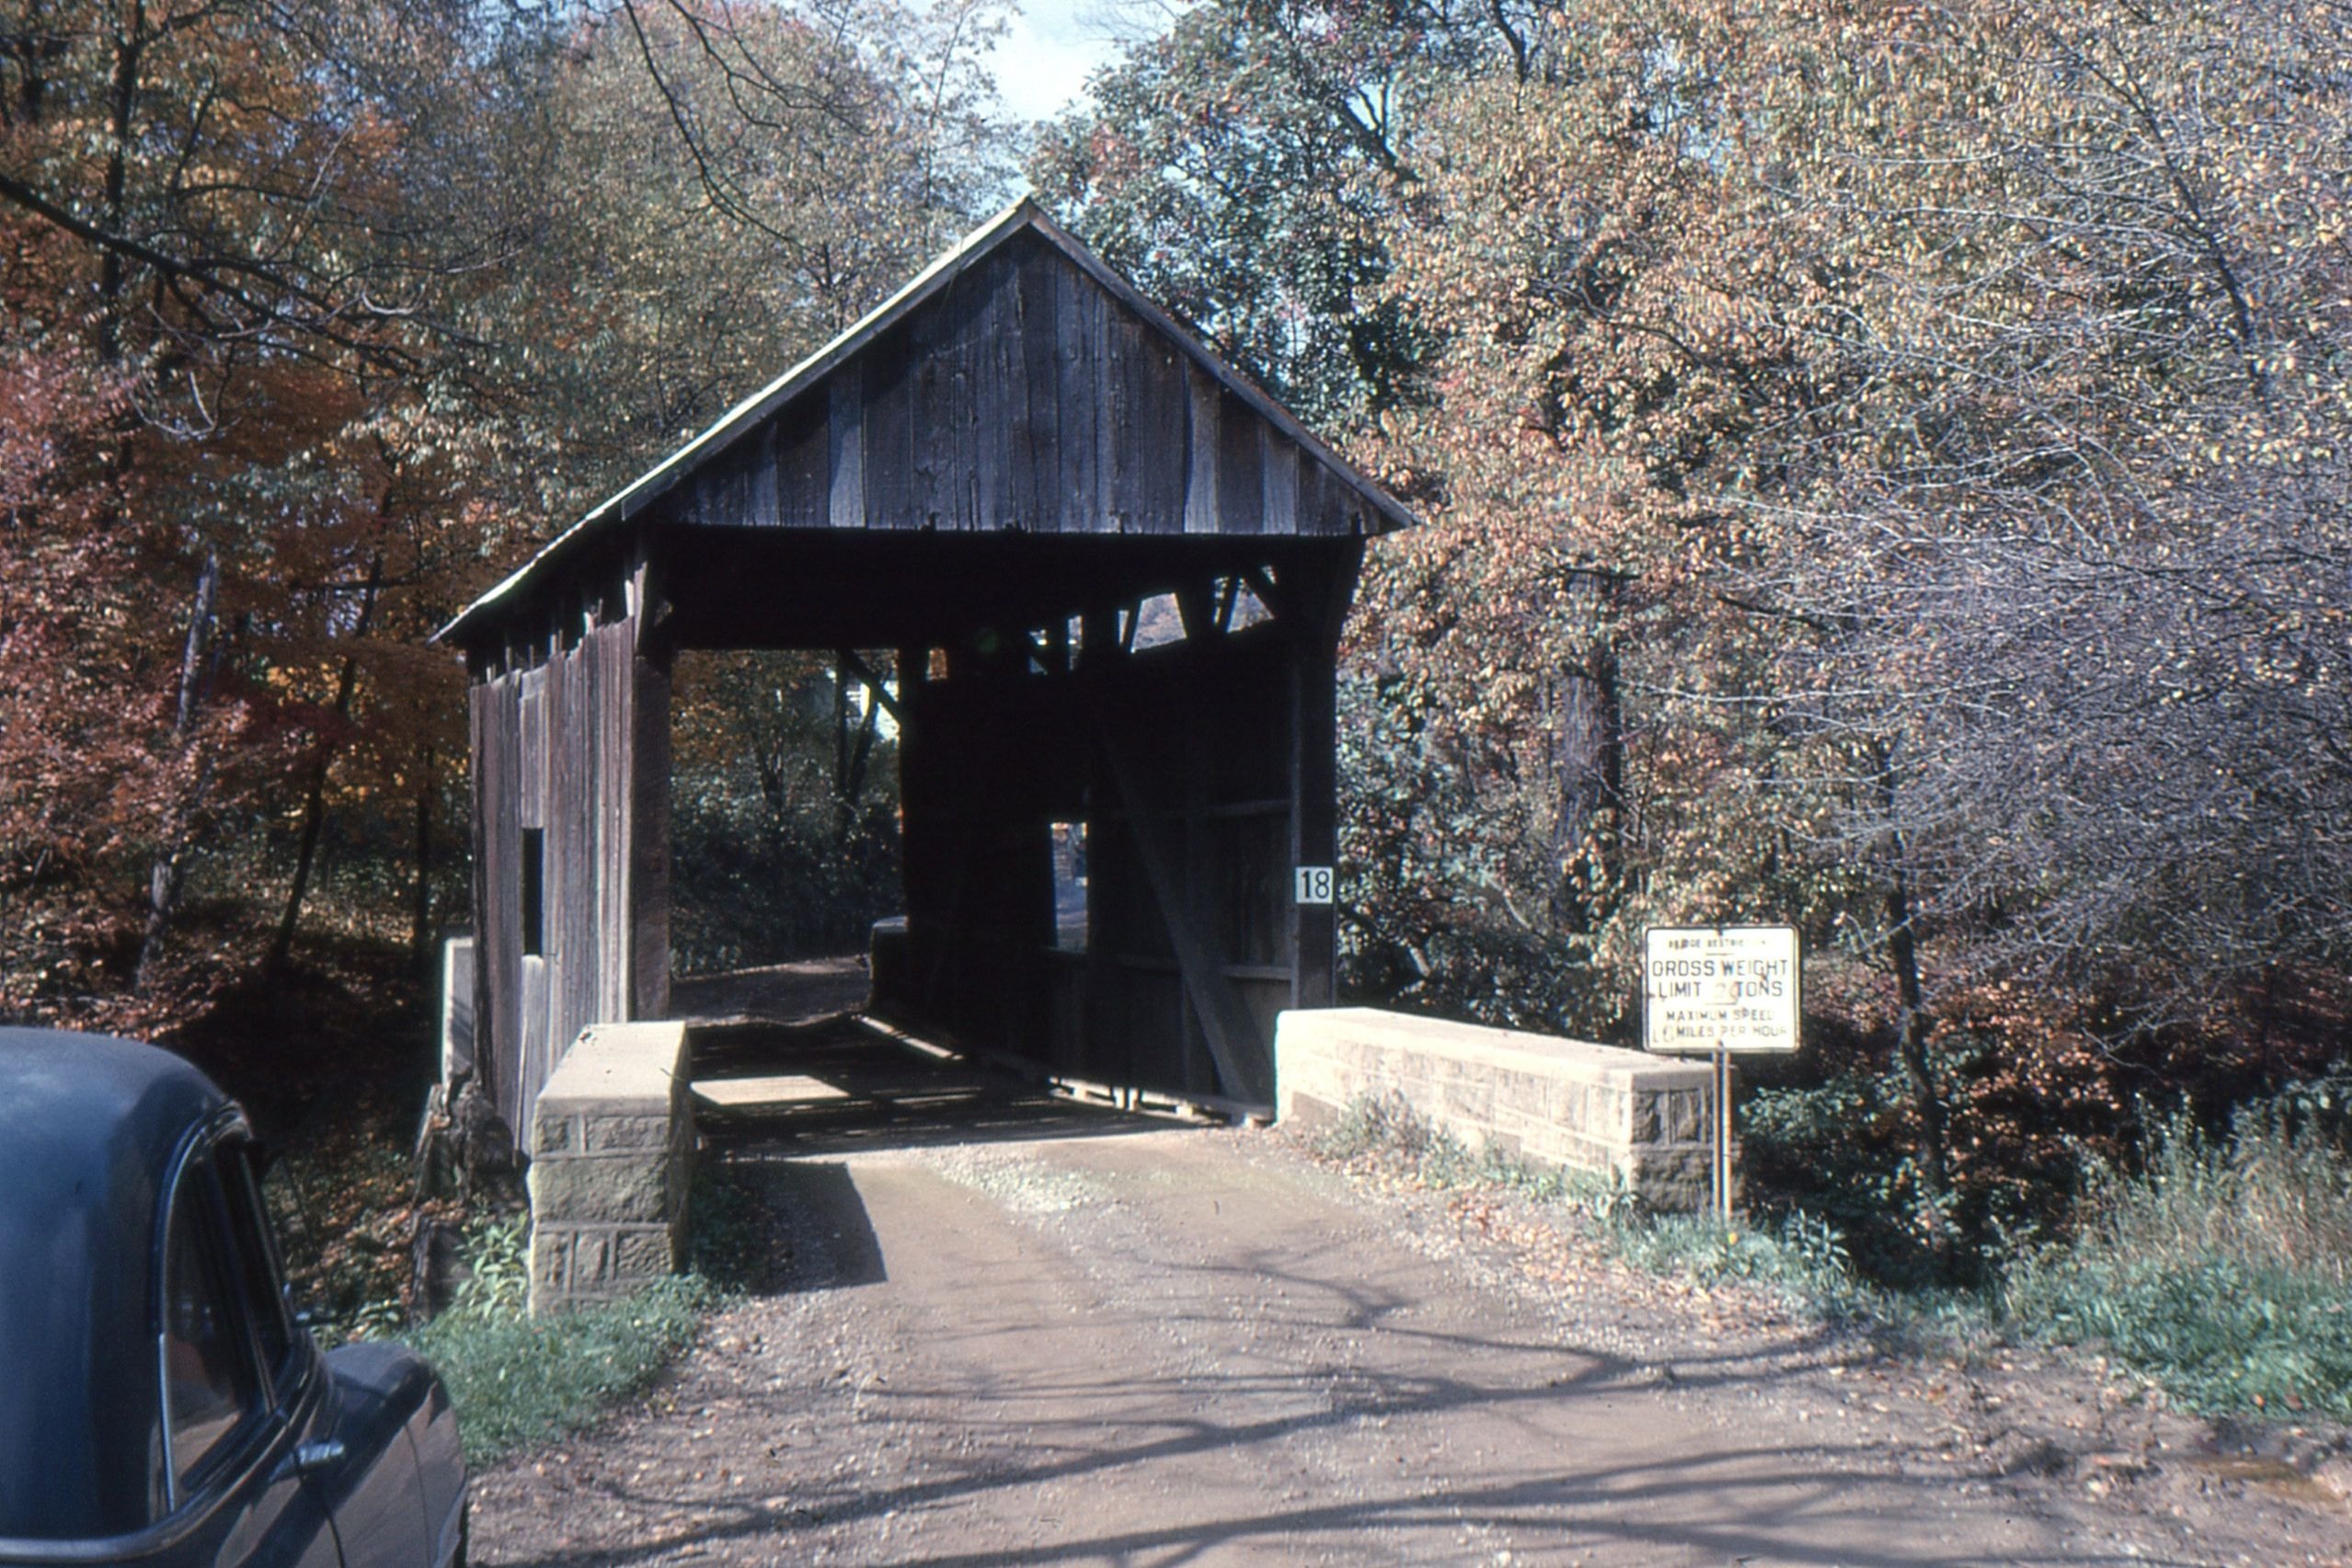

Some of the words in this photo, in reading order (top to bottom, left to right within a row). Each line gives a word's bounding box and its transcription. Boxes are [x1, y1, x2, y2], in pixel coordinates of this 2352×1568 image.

[1301, 870, 1330, 898] 18
[1652, 959, 1715, 977] GROSS
[1720, 959, 1788, 977] WEIGHT
[1658, 981, 1702, 999] LIMIT
[1733, 980, 1783, 998] TONS
[1666, 1010, 1727, 1022] MAXIMUM
[1732, 1008, 1774, 1021] SPEED
[1676, 1025, 1715, 1037] MILES
[1720, 1025, 1746, 1037] PER
[1752, 1025, 1787, 1037] HOUR
